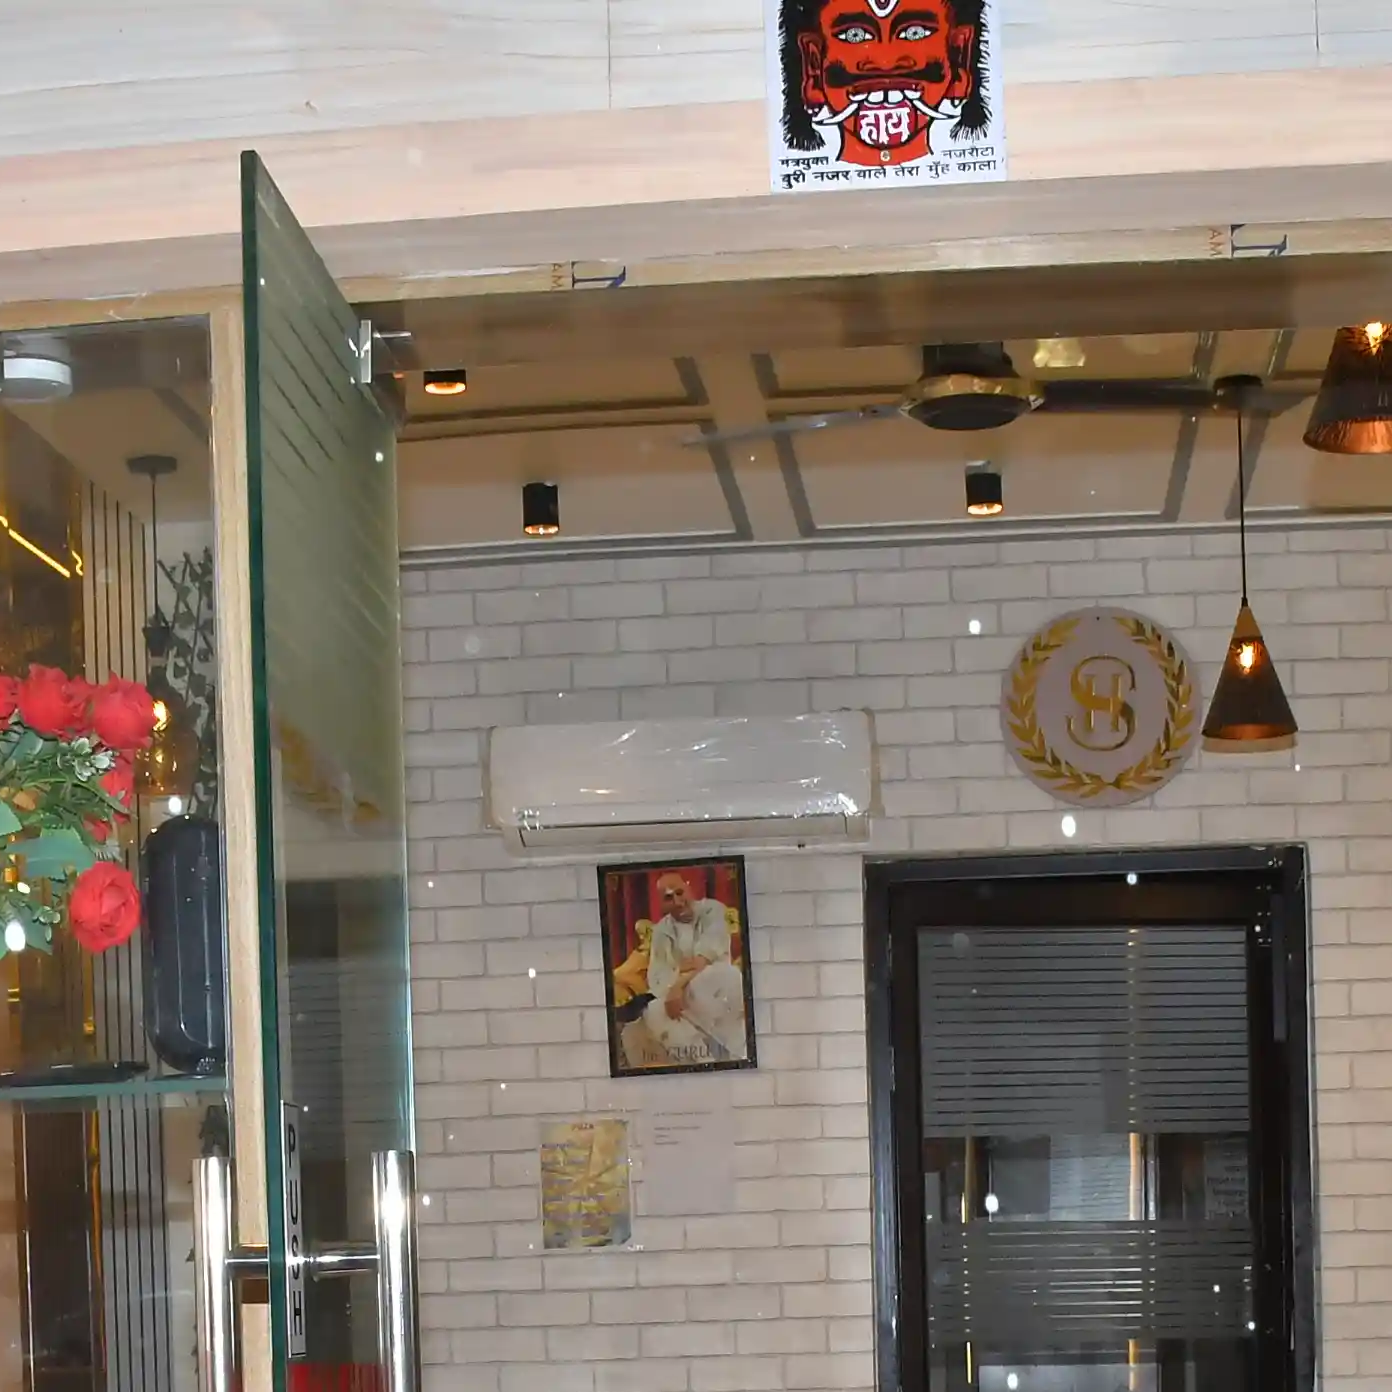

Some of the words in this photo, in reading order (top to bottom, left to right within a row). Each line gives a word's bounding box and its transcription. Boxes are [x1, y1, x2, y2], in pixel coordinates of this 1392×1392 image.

[859, 107, 910, 145] हाय
[812, 170, 851, 182] नजर
[956, 160, 997, 173] काला
[288, 1123, 303, 1335] PUSH
